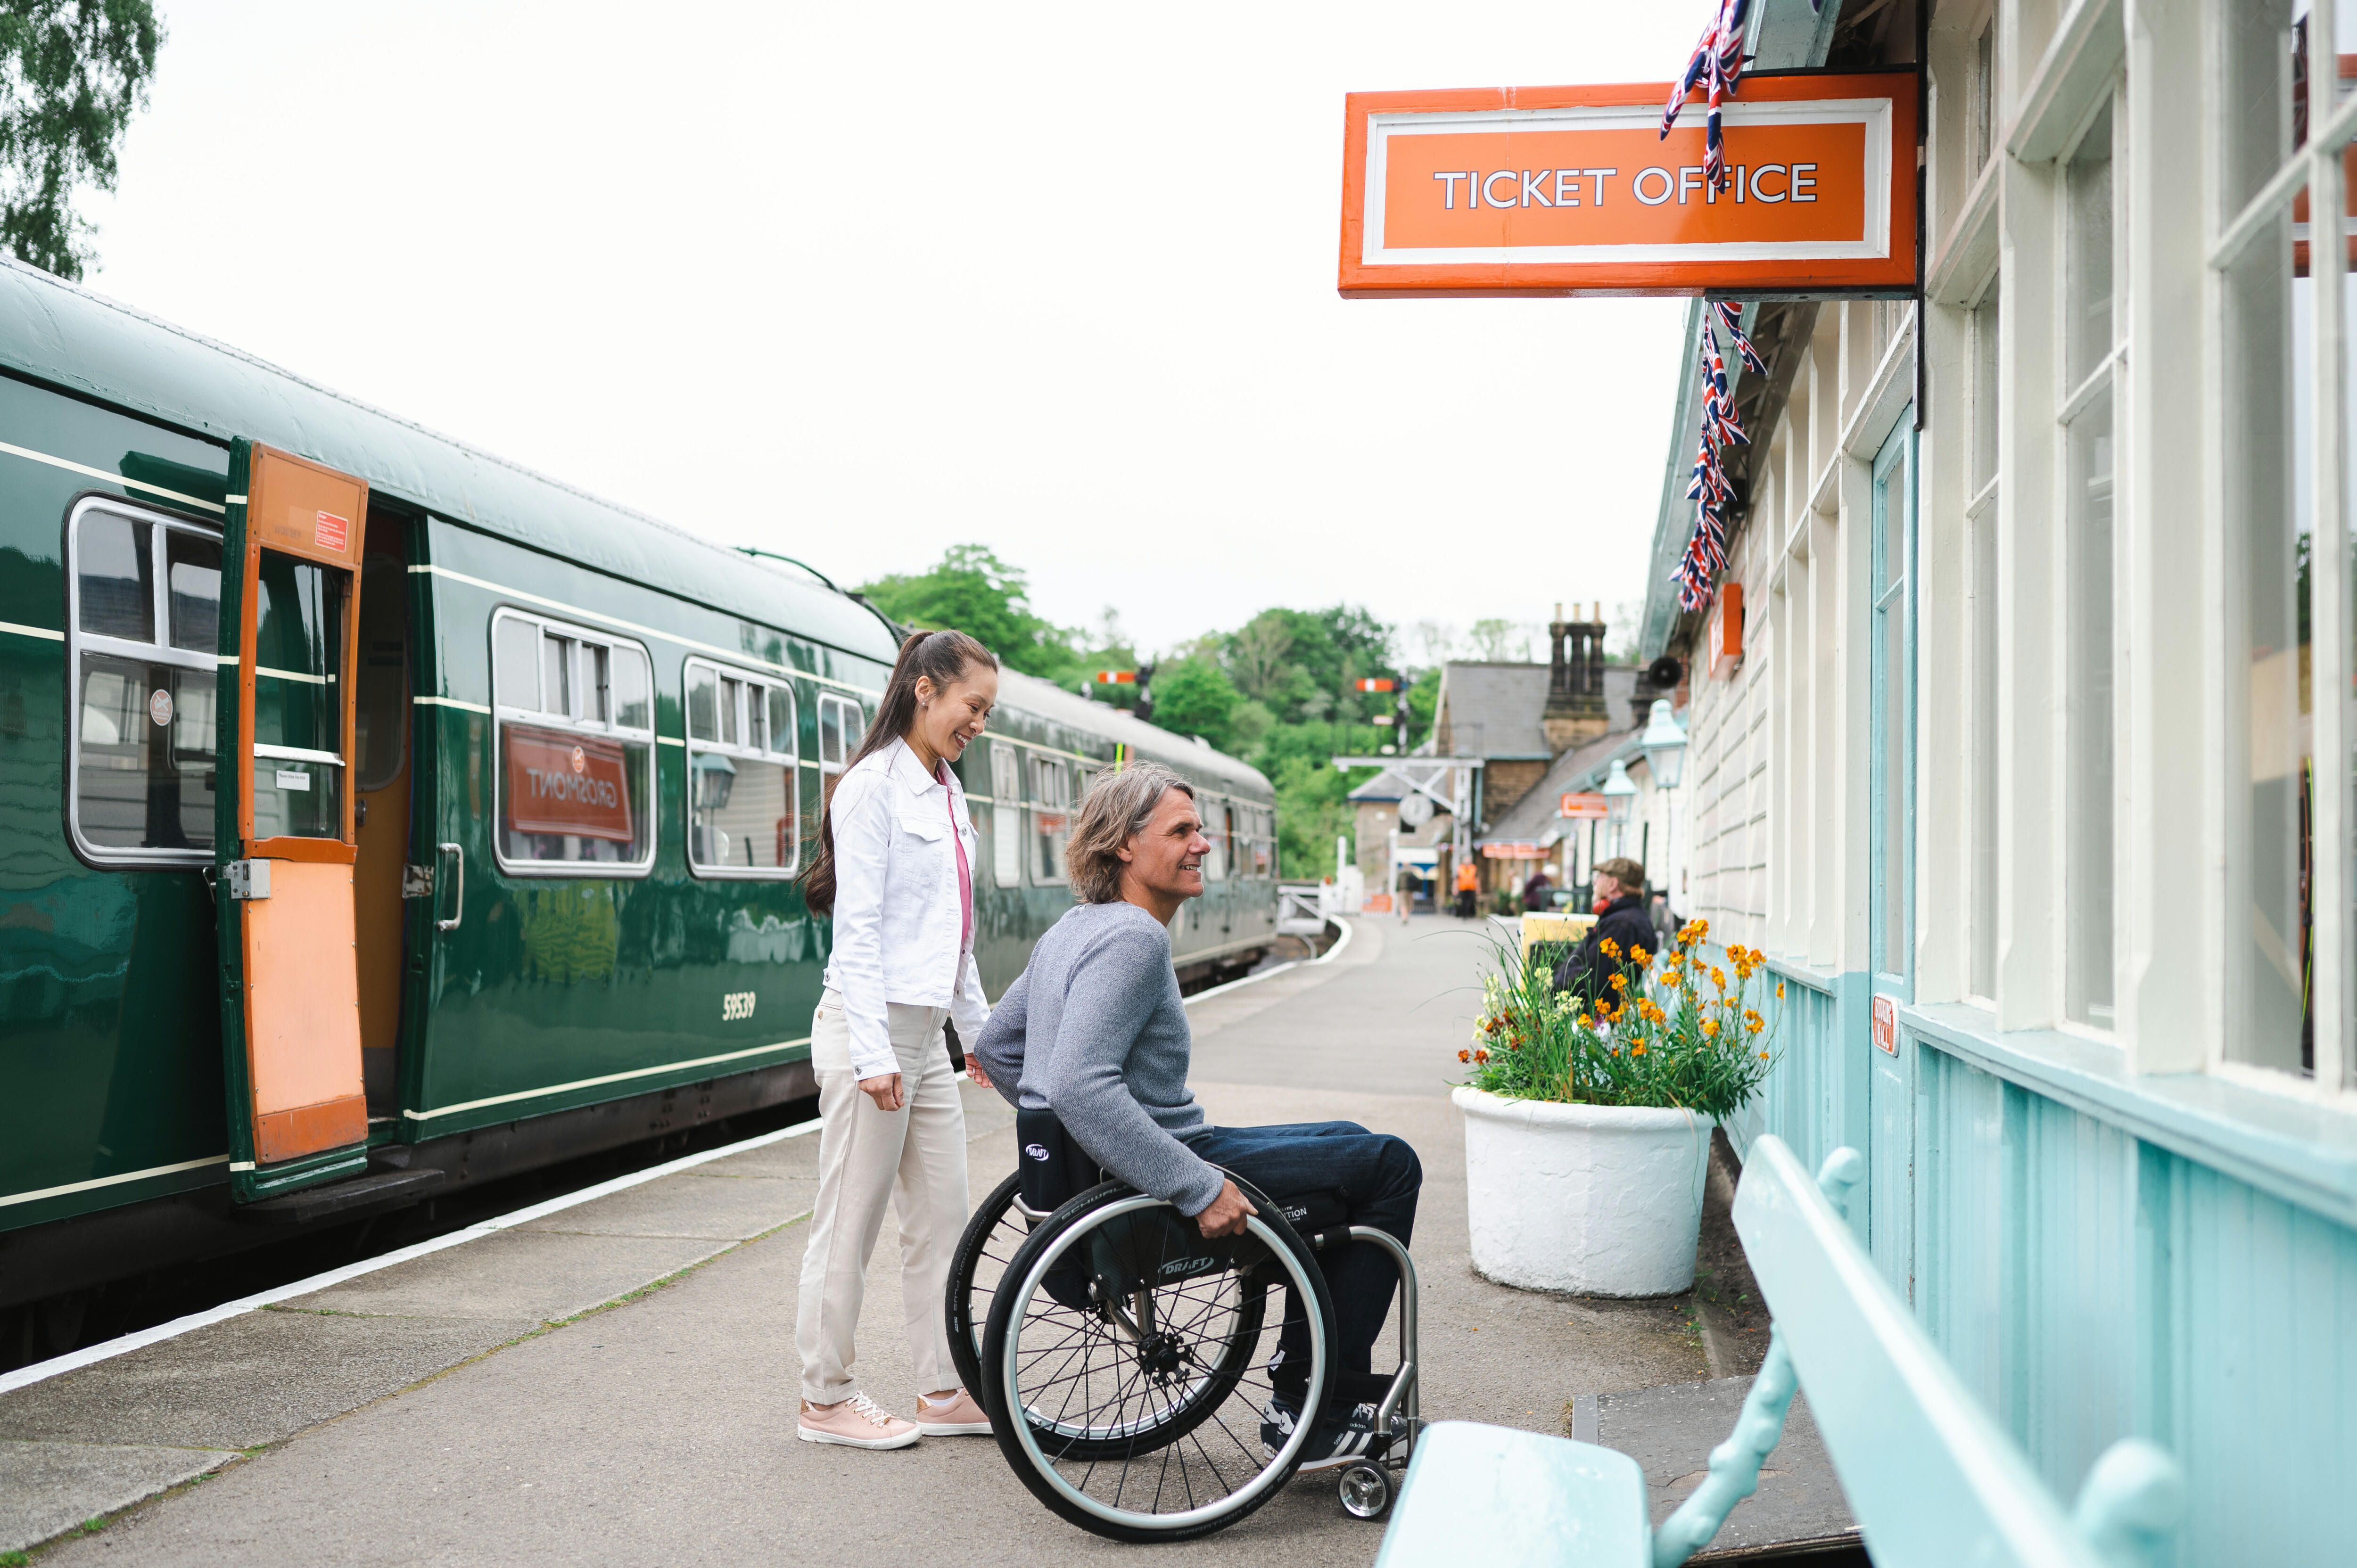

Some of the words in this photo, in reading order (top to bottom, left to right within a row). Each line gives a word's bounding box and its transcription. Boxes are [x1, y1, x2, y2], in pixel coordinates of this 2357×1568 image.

[1434, 168, 1617, 209] TICKET
[1632, 163, 1817, 205] OFFICE
[723, 991, 756, 1021] 59539
[1875, 998, 1892, 1026] BOOKING
[1878, 1023, 1889, 1050] HALL
[1029, 1147, 1047, 1158] DRAFT
[1062, 1184, 1128, 1221] SCHWAL
[1165, 1257, 1208, 1274] DRAFT
[1334, 1433, 1344, 1445] SAMBA
[1176, 1509, 1242, 1536] MARATHON
[1246, 1485, 1274, 1509] PLUS
